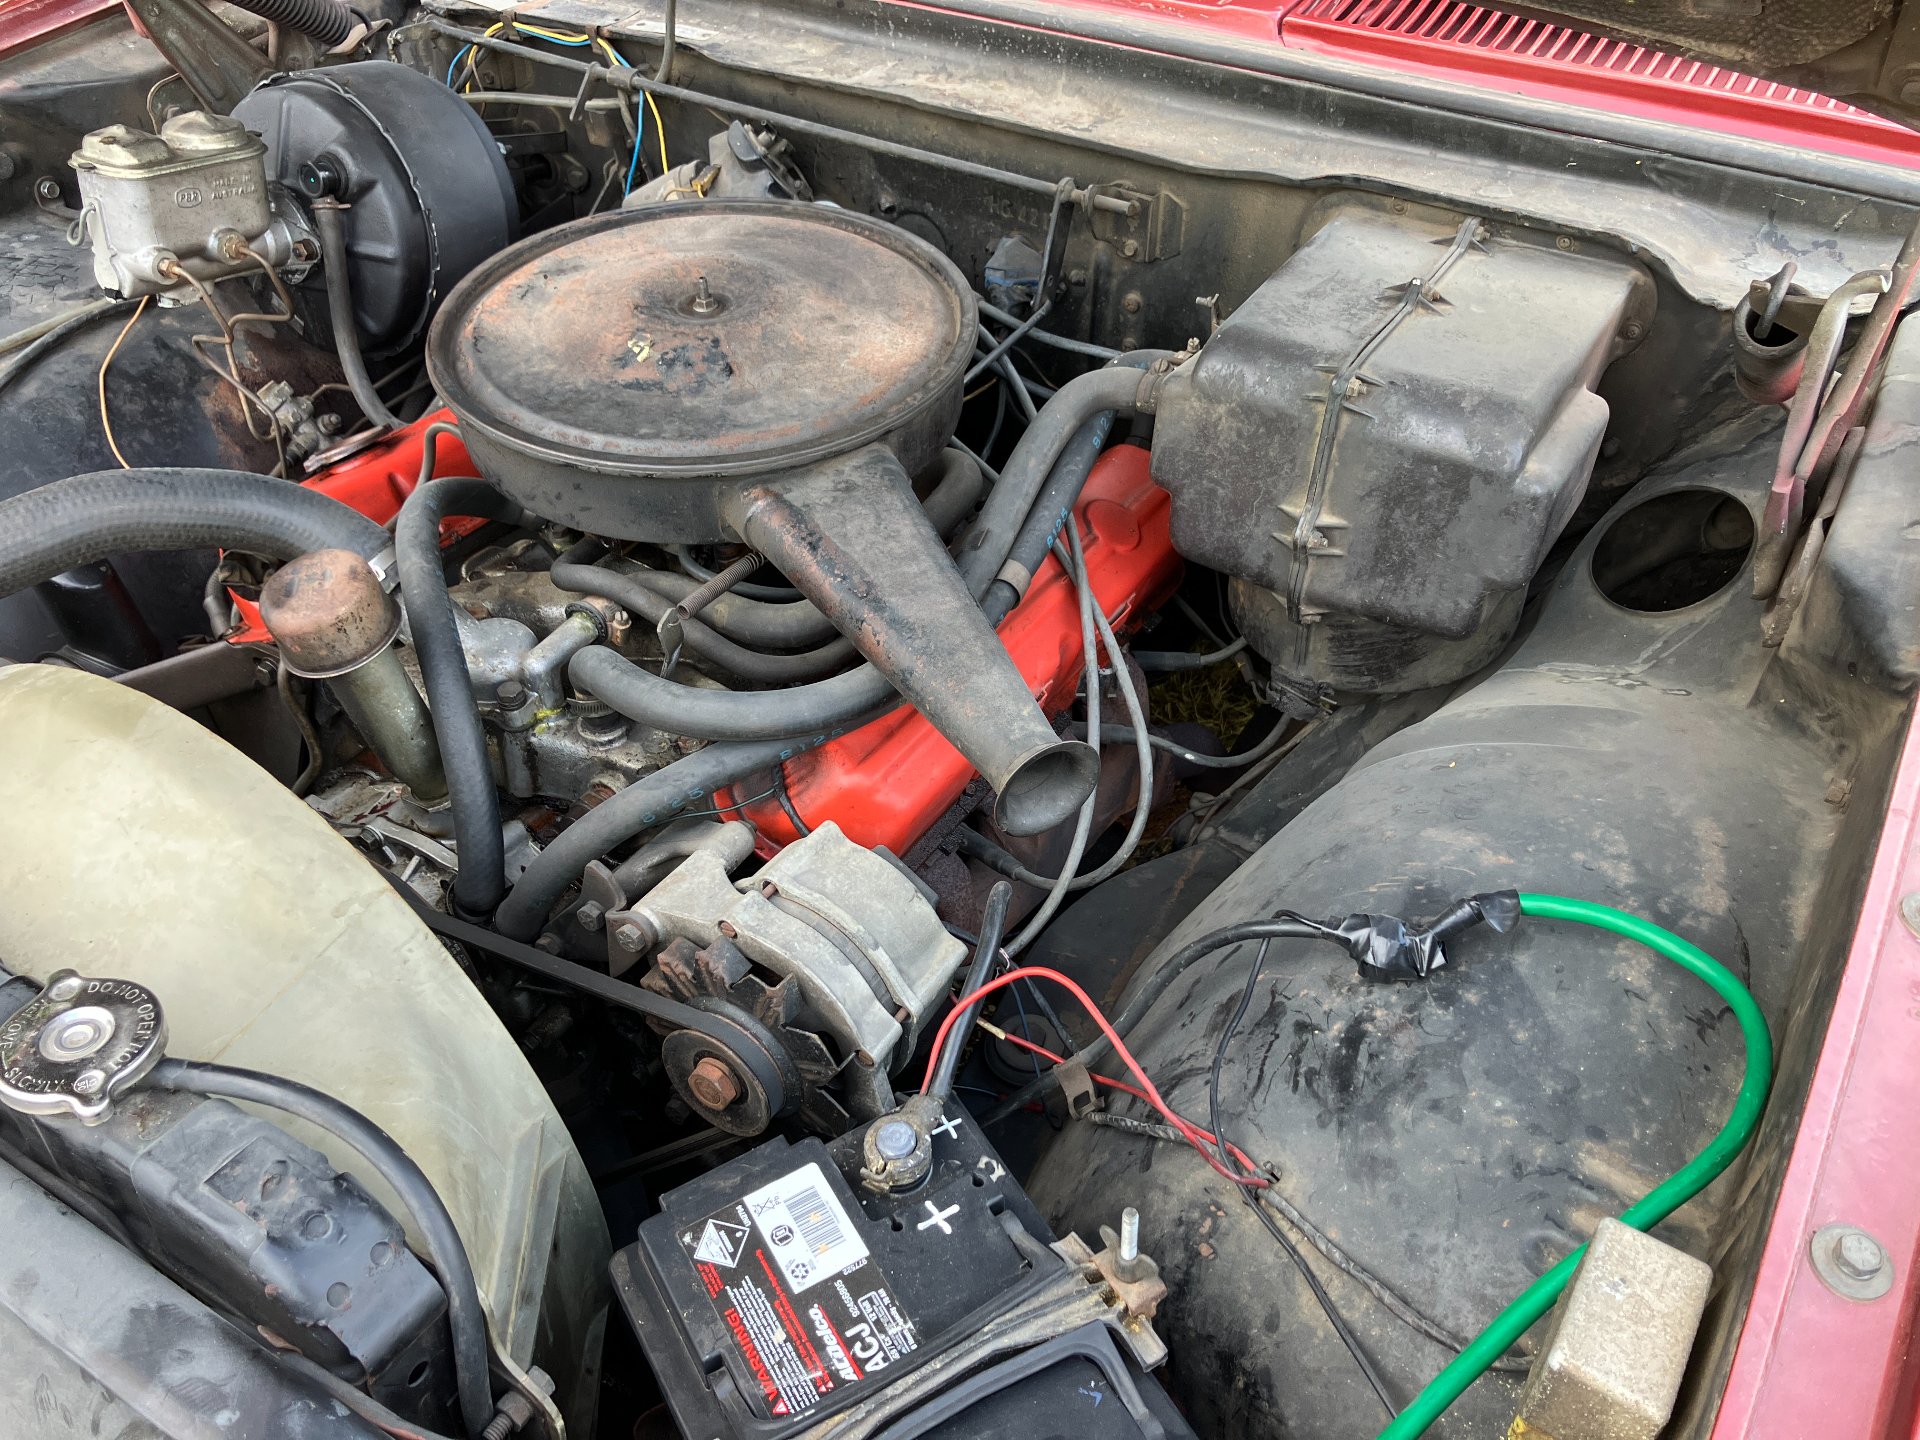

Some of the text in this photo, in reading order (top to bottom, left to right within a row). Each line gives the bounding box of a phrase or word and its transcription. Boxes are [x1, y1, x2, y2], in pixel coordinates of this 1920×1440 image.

[212, 185, 257, 201] AUSTRALIA
[88, 981, 113, 993] DO
[114, 984, 148, 1004] NOT
[135, 1003, 156, 1039] OPEN
[833, 1277, 862, 1319] 92456805
[722, 1307, 782, 1403] WARNING!
[805, 1304, 859, 1388] ACDelco
[844, 1320, 890, 1376] ACJ
